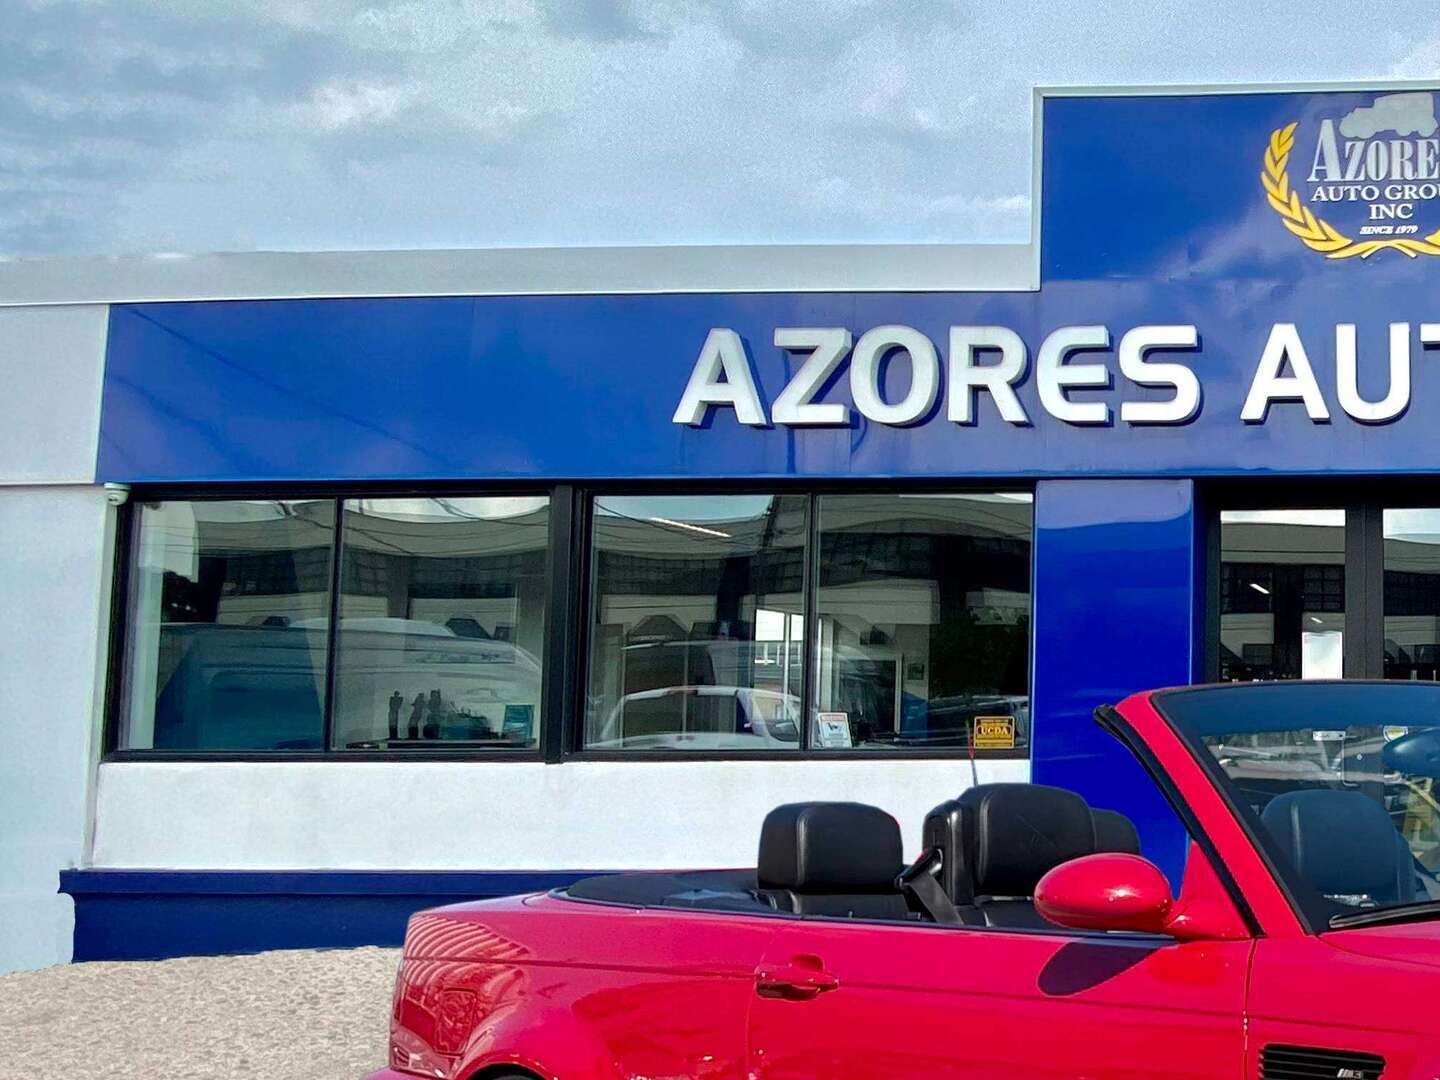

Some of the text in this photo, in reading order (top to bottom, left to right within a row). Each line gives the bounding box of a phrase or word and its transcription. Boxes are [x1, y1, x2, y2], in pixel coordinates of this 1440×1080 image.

[1311, 185, 1379, 202] AUTO
[1368, 203, 1413, 220] INC
[671, 324, 1202, 427] AZORES
[980, 726, 1008, 736] UCDA
